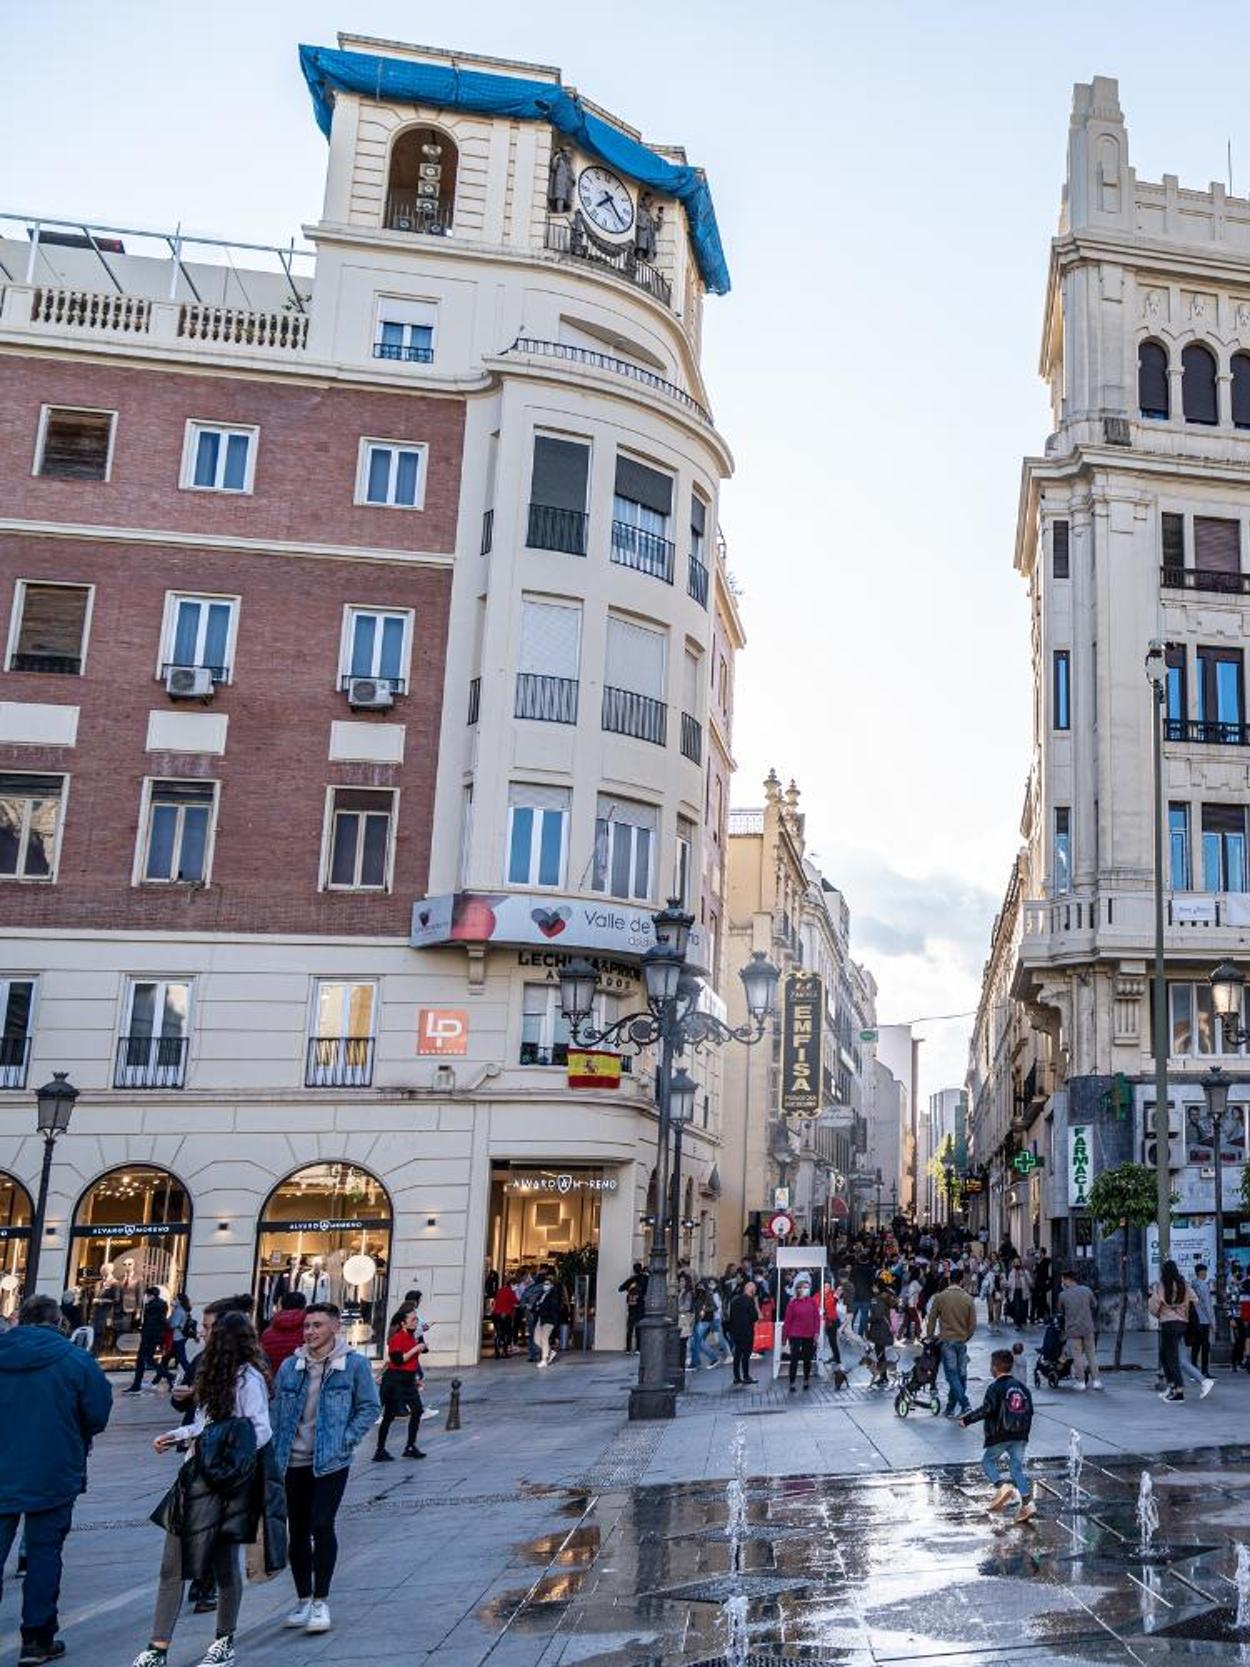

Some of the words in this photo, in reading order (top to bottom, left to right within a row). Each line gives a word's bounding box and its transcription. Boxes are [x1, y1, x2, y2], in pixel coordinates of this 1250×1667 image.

[584, 909, 626, 931] Valle
[629, 917, 650, 935] de
[791, 1004, 813, 1091] EMFISA
[1072, 1126, 1089, 1204] FARMACIA
